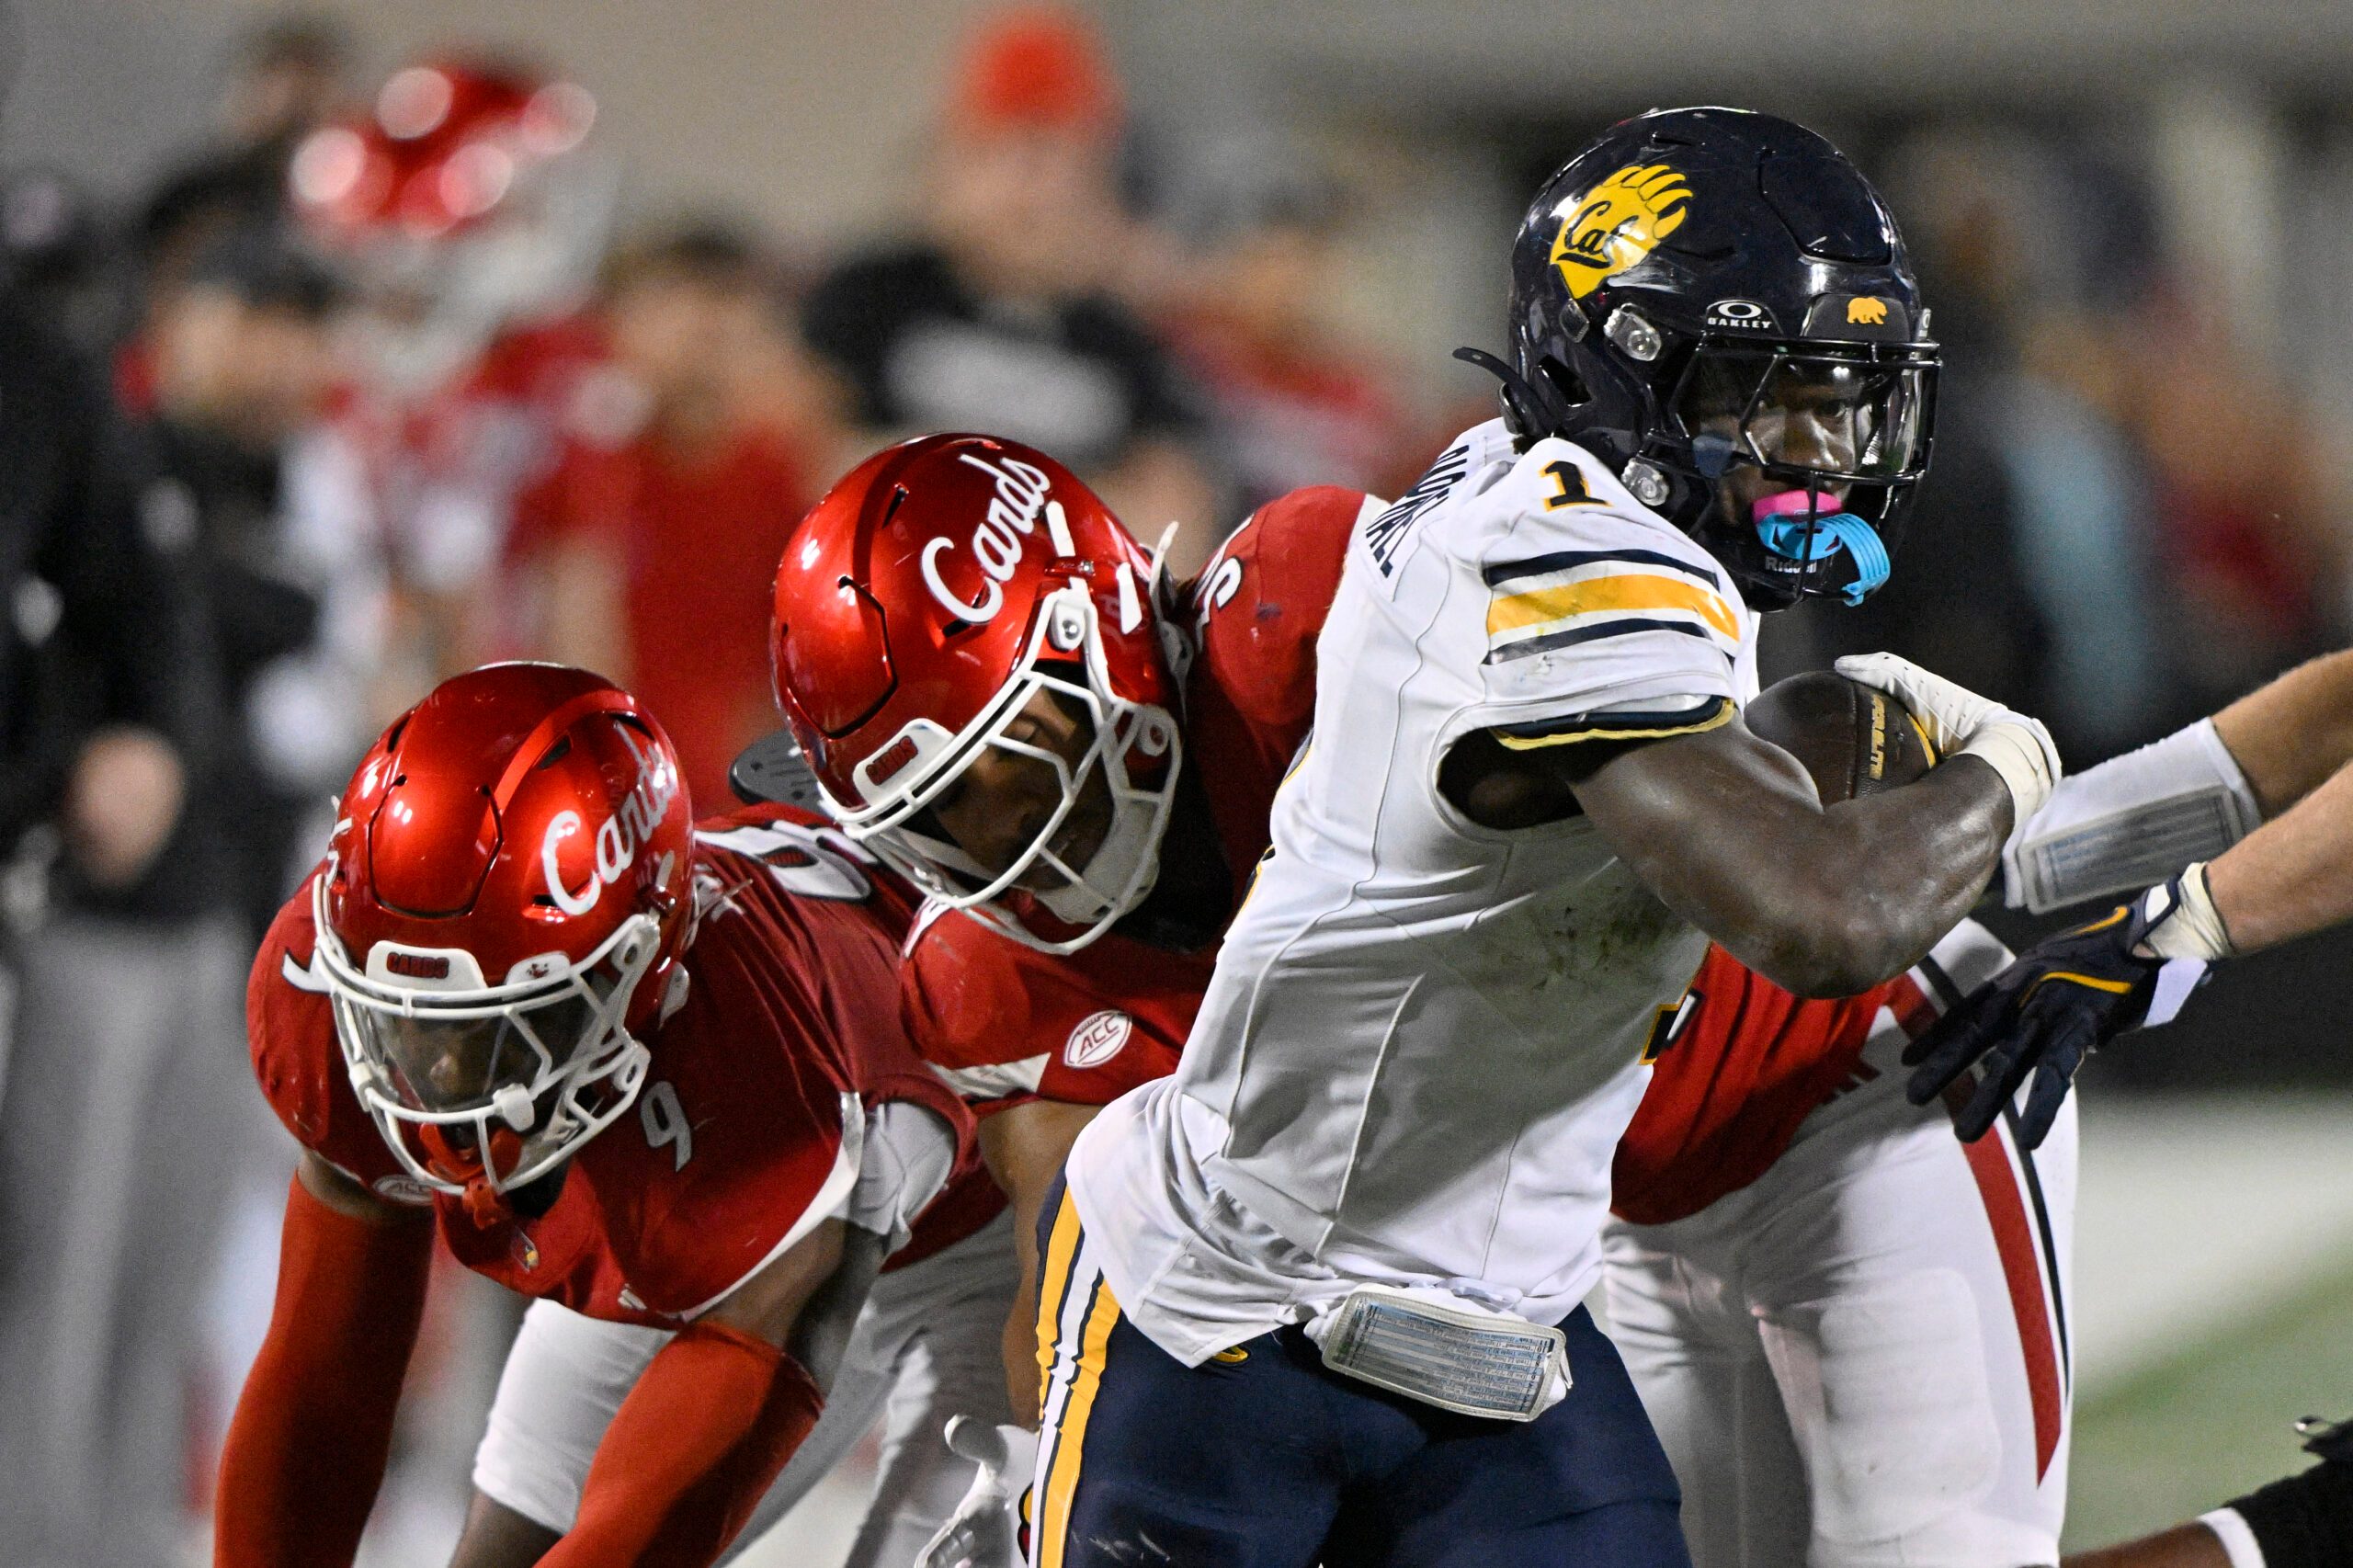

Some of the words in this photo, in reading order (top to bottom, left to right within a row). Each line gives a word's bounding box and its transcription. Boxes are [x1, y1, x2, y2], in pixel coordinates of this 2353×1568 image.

[1707, 317, 1772, 329] OAKLEY
[1538, 460, 1614, 512] 1
[921, 453, 1051, 625] Cards
[540, 720, 680, 916] Cards
[386, 951, 450, 980] CARDS
[1078, 1014, 1120, 1058] ACC
[640, 1080, 693, 1173] 9
